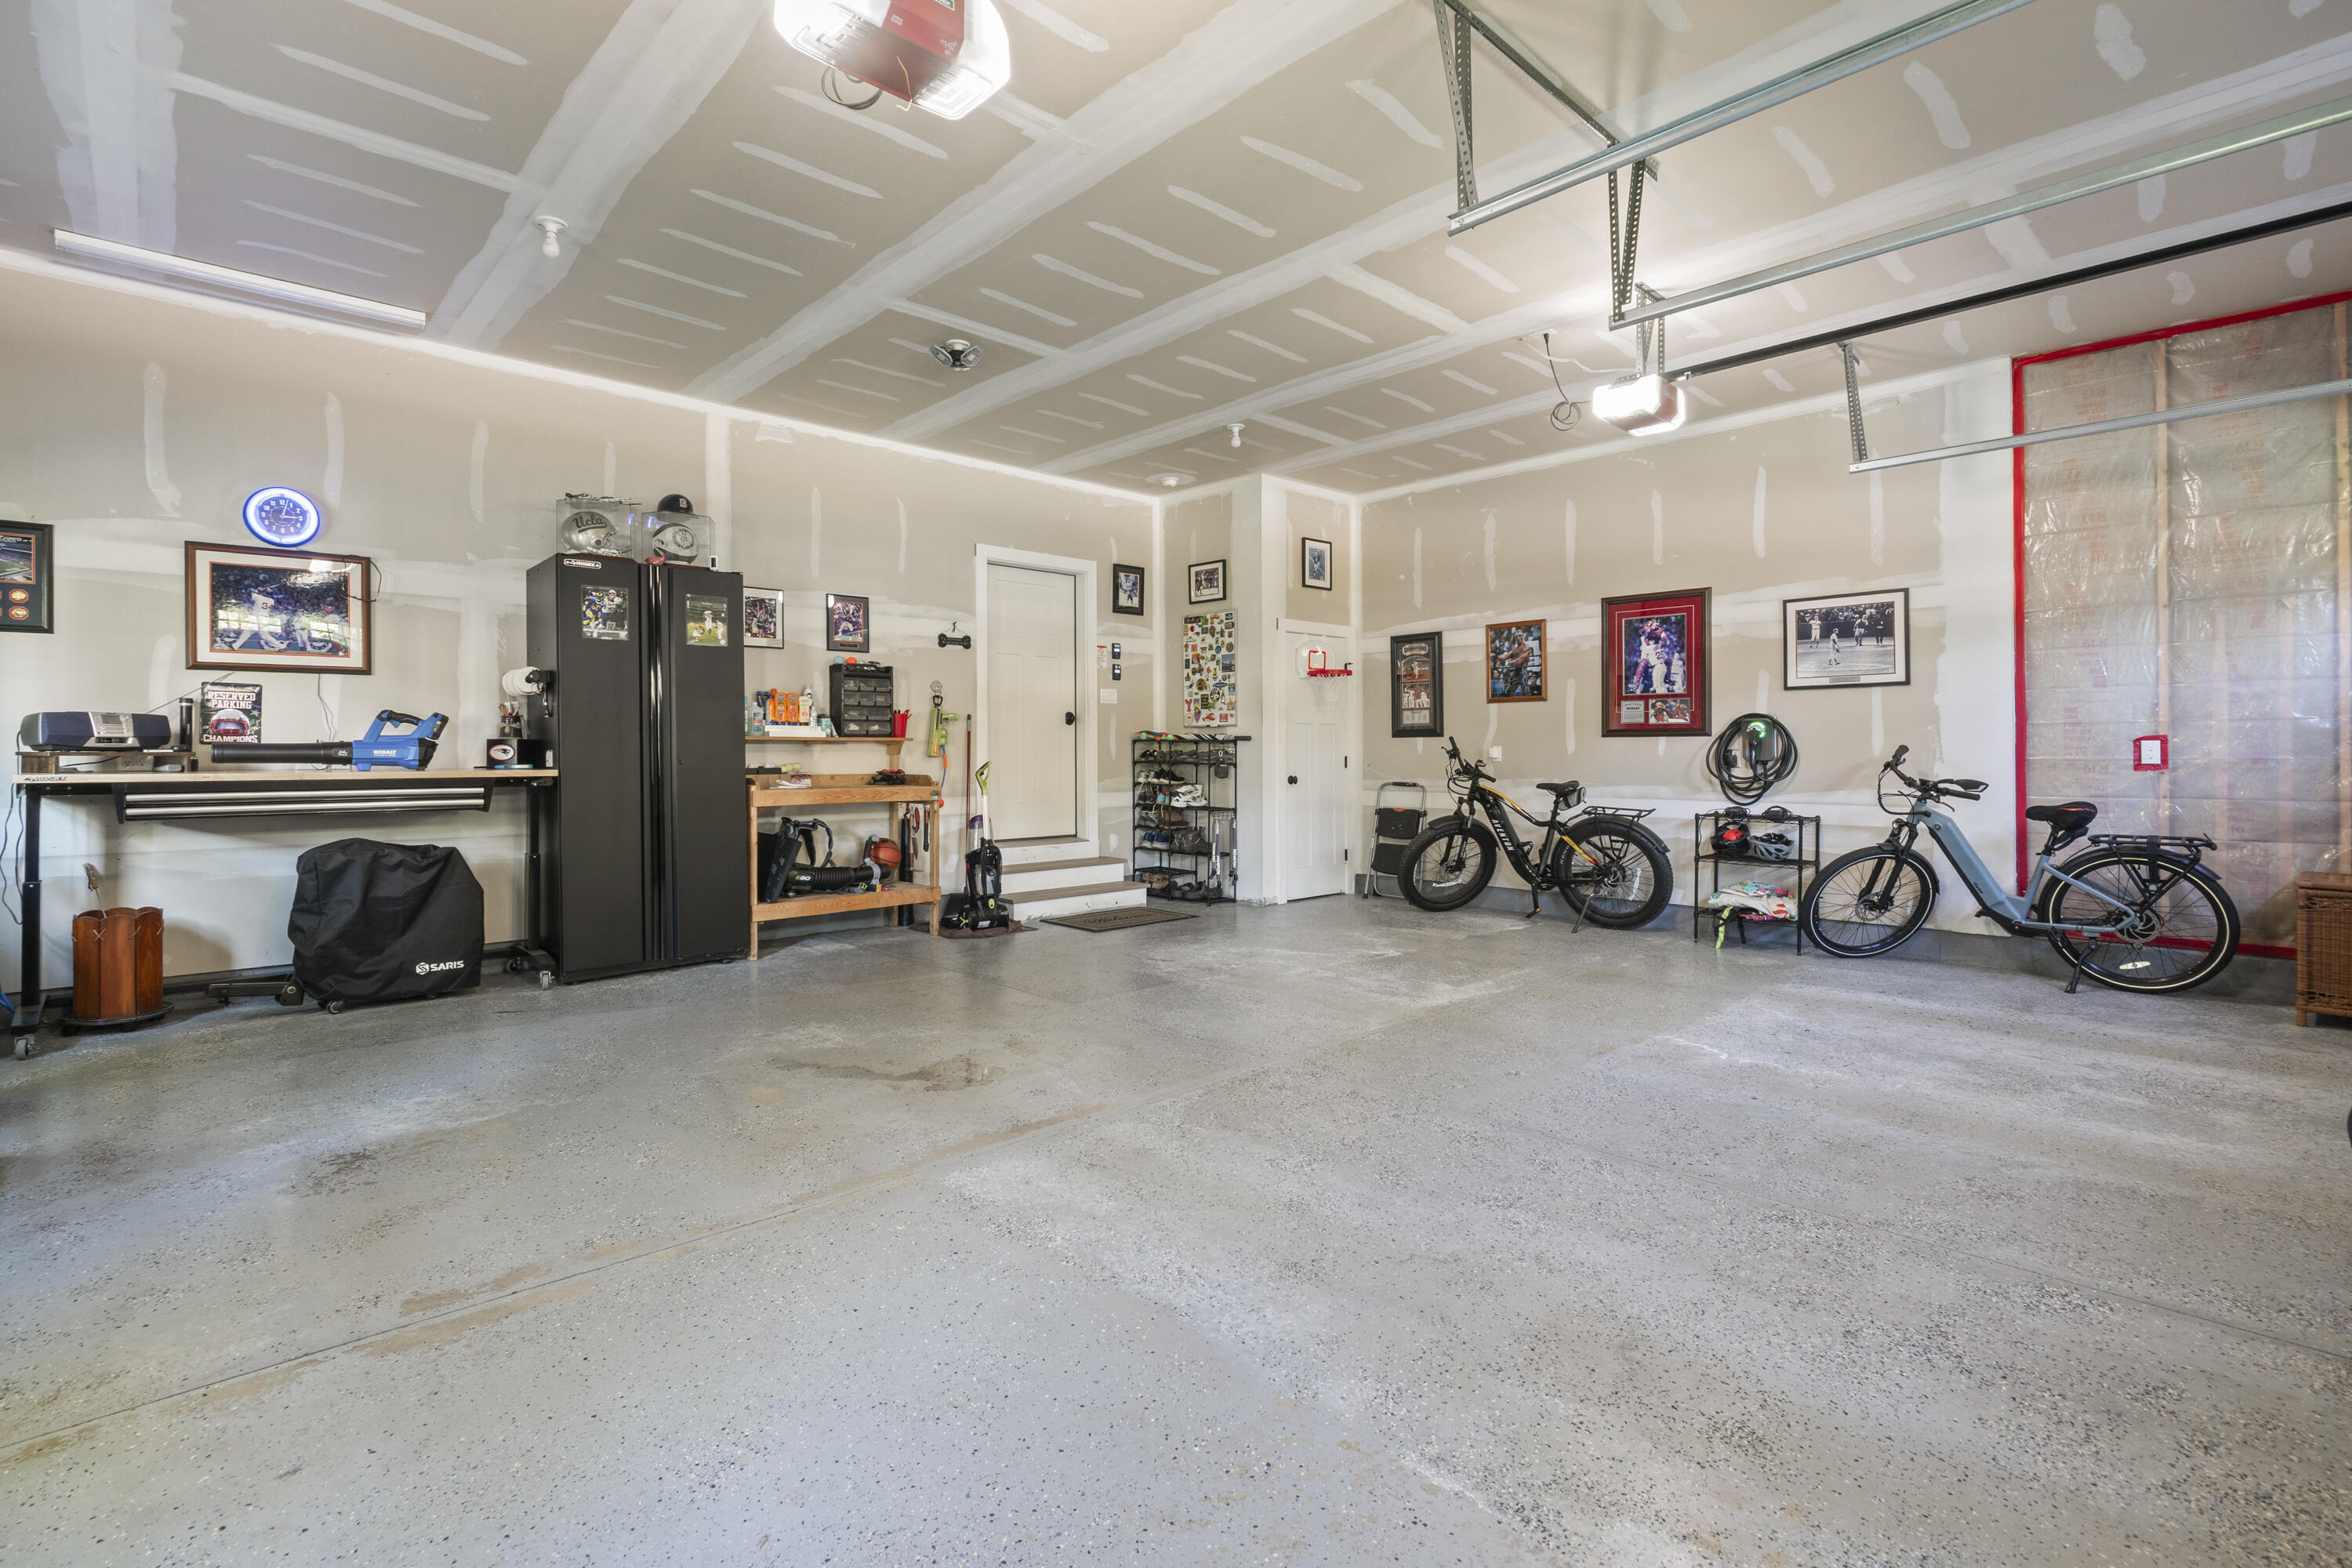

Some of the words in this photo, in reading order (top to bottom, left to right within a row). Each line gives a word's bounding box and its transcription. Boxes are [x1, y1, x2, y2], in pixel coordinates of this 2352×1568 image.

[206, 691, 256, 701] RESERVED
[212, 699, 252, 710] PARKING
[203, 734, 259, 743] CHAMPIONS
[1491, 819, 1515, 851] AVENTON
[430, 960, 465, 971] SARIS
